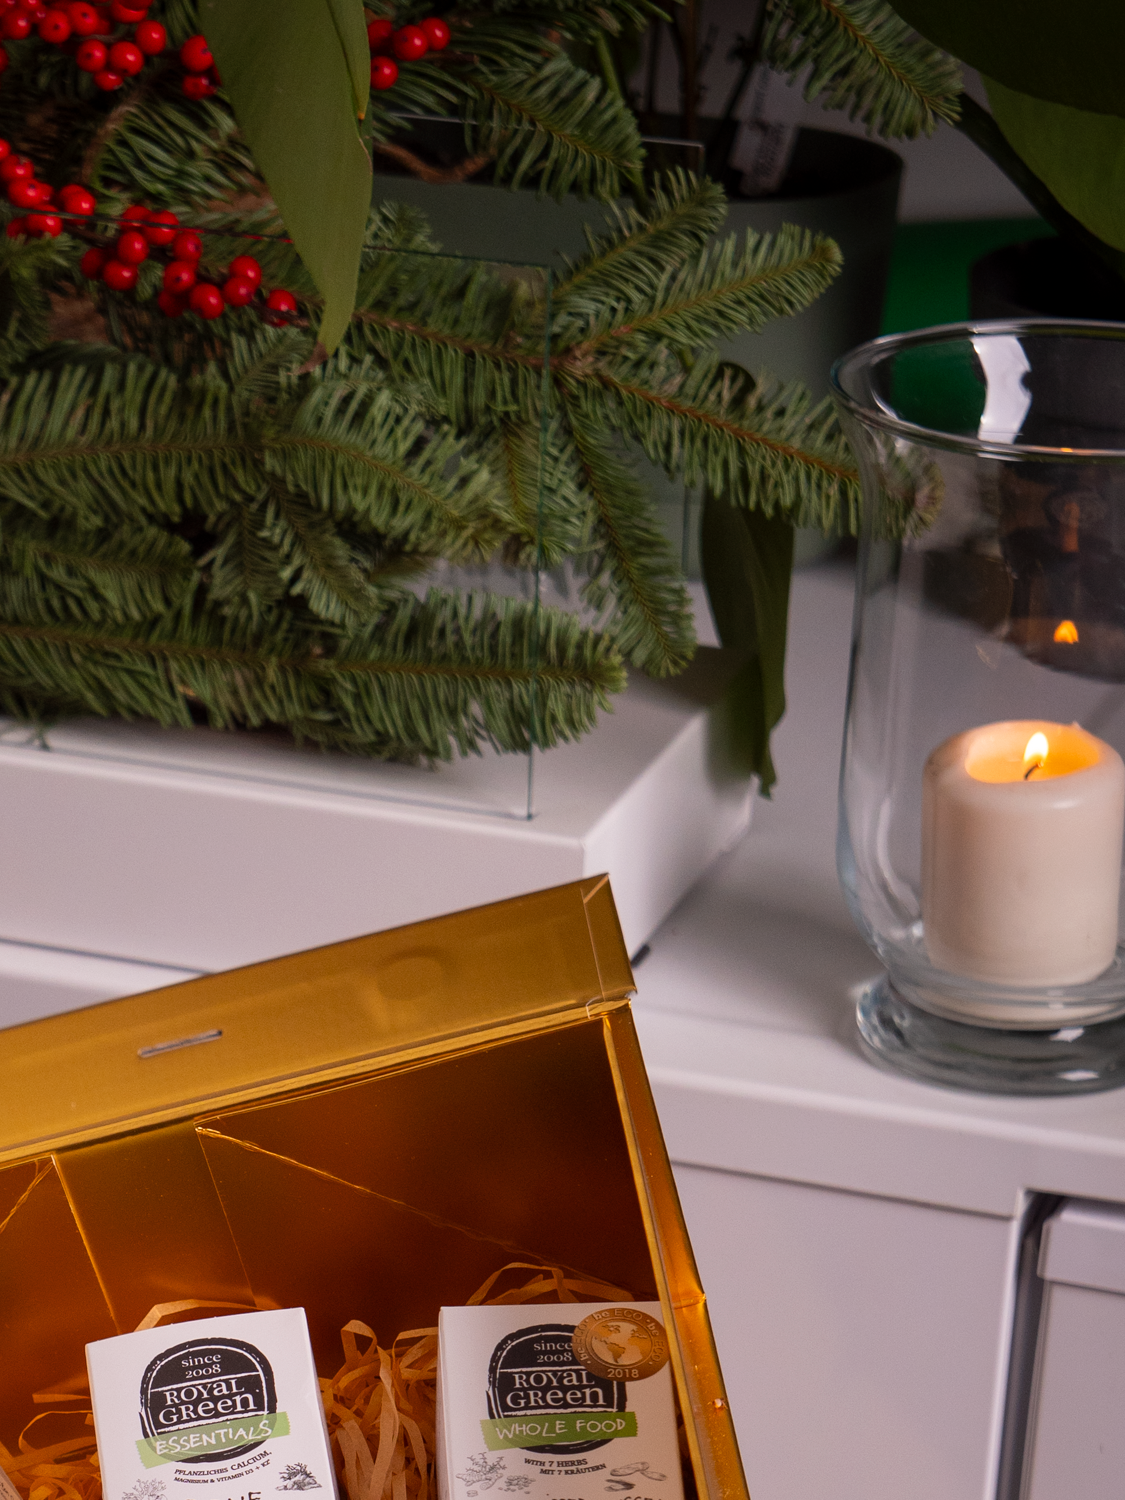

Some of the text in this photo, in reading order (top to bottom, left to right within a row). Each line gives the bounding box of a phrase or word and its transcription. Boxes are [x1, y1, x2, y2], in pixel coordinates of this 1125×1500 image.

[592, 1308, 643, 1320] be ECO
[647, 1323, 660, 1336] be
[533, 1340, 573, 1351] since
[181, 1353, 222, 1368] since
[536, 1352, 573, 1363] 2008
[185, 1363, 222, 1379] 2008
[607, 1368, 639, 1378] 2018
[495, 1418, 626, 1440] WHOLE FOOD
[524, 1458, 546, 1467] WITH
[556, 1458, 588, 1467] HERBS
[174, 1467, 229, 1476] PFLANZLICHES
[216, 1473, 245, 1483] VITAMIN
